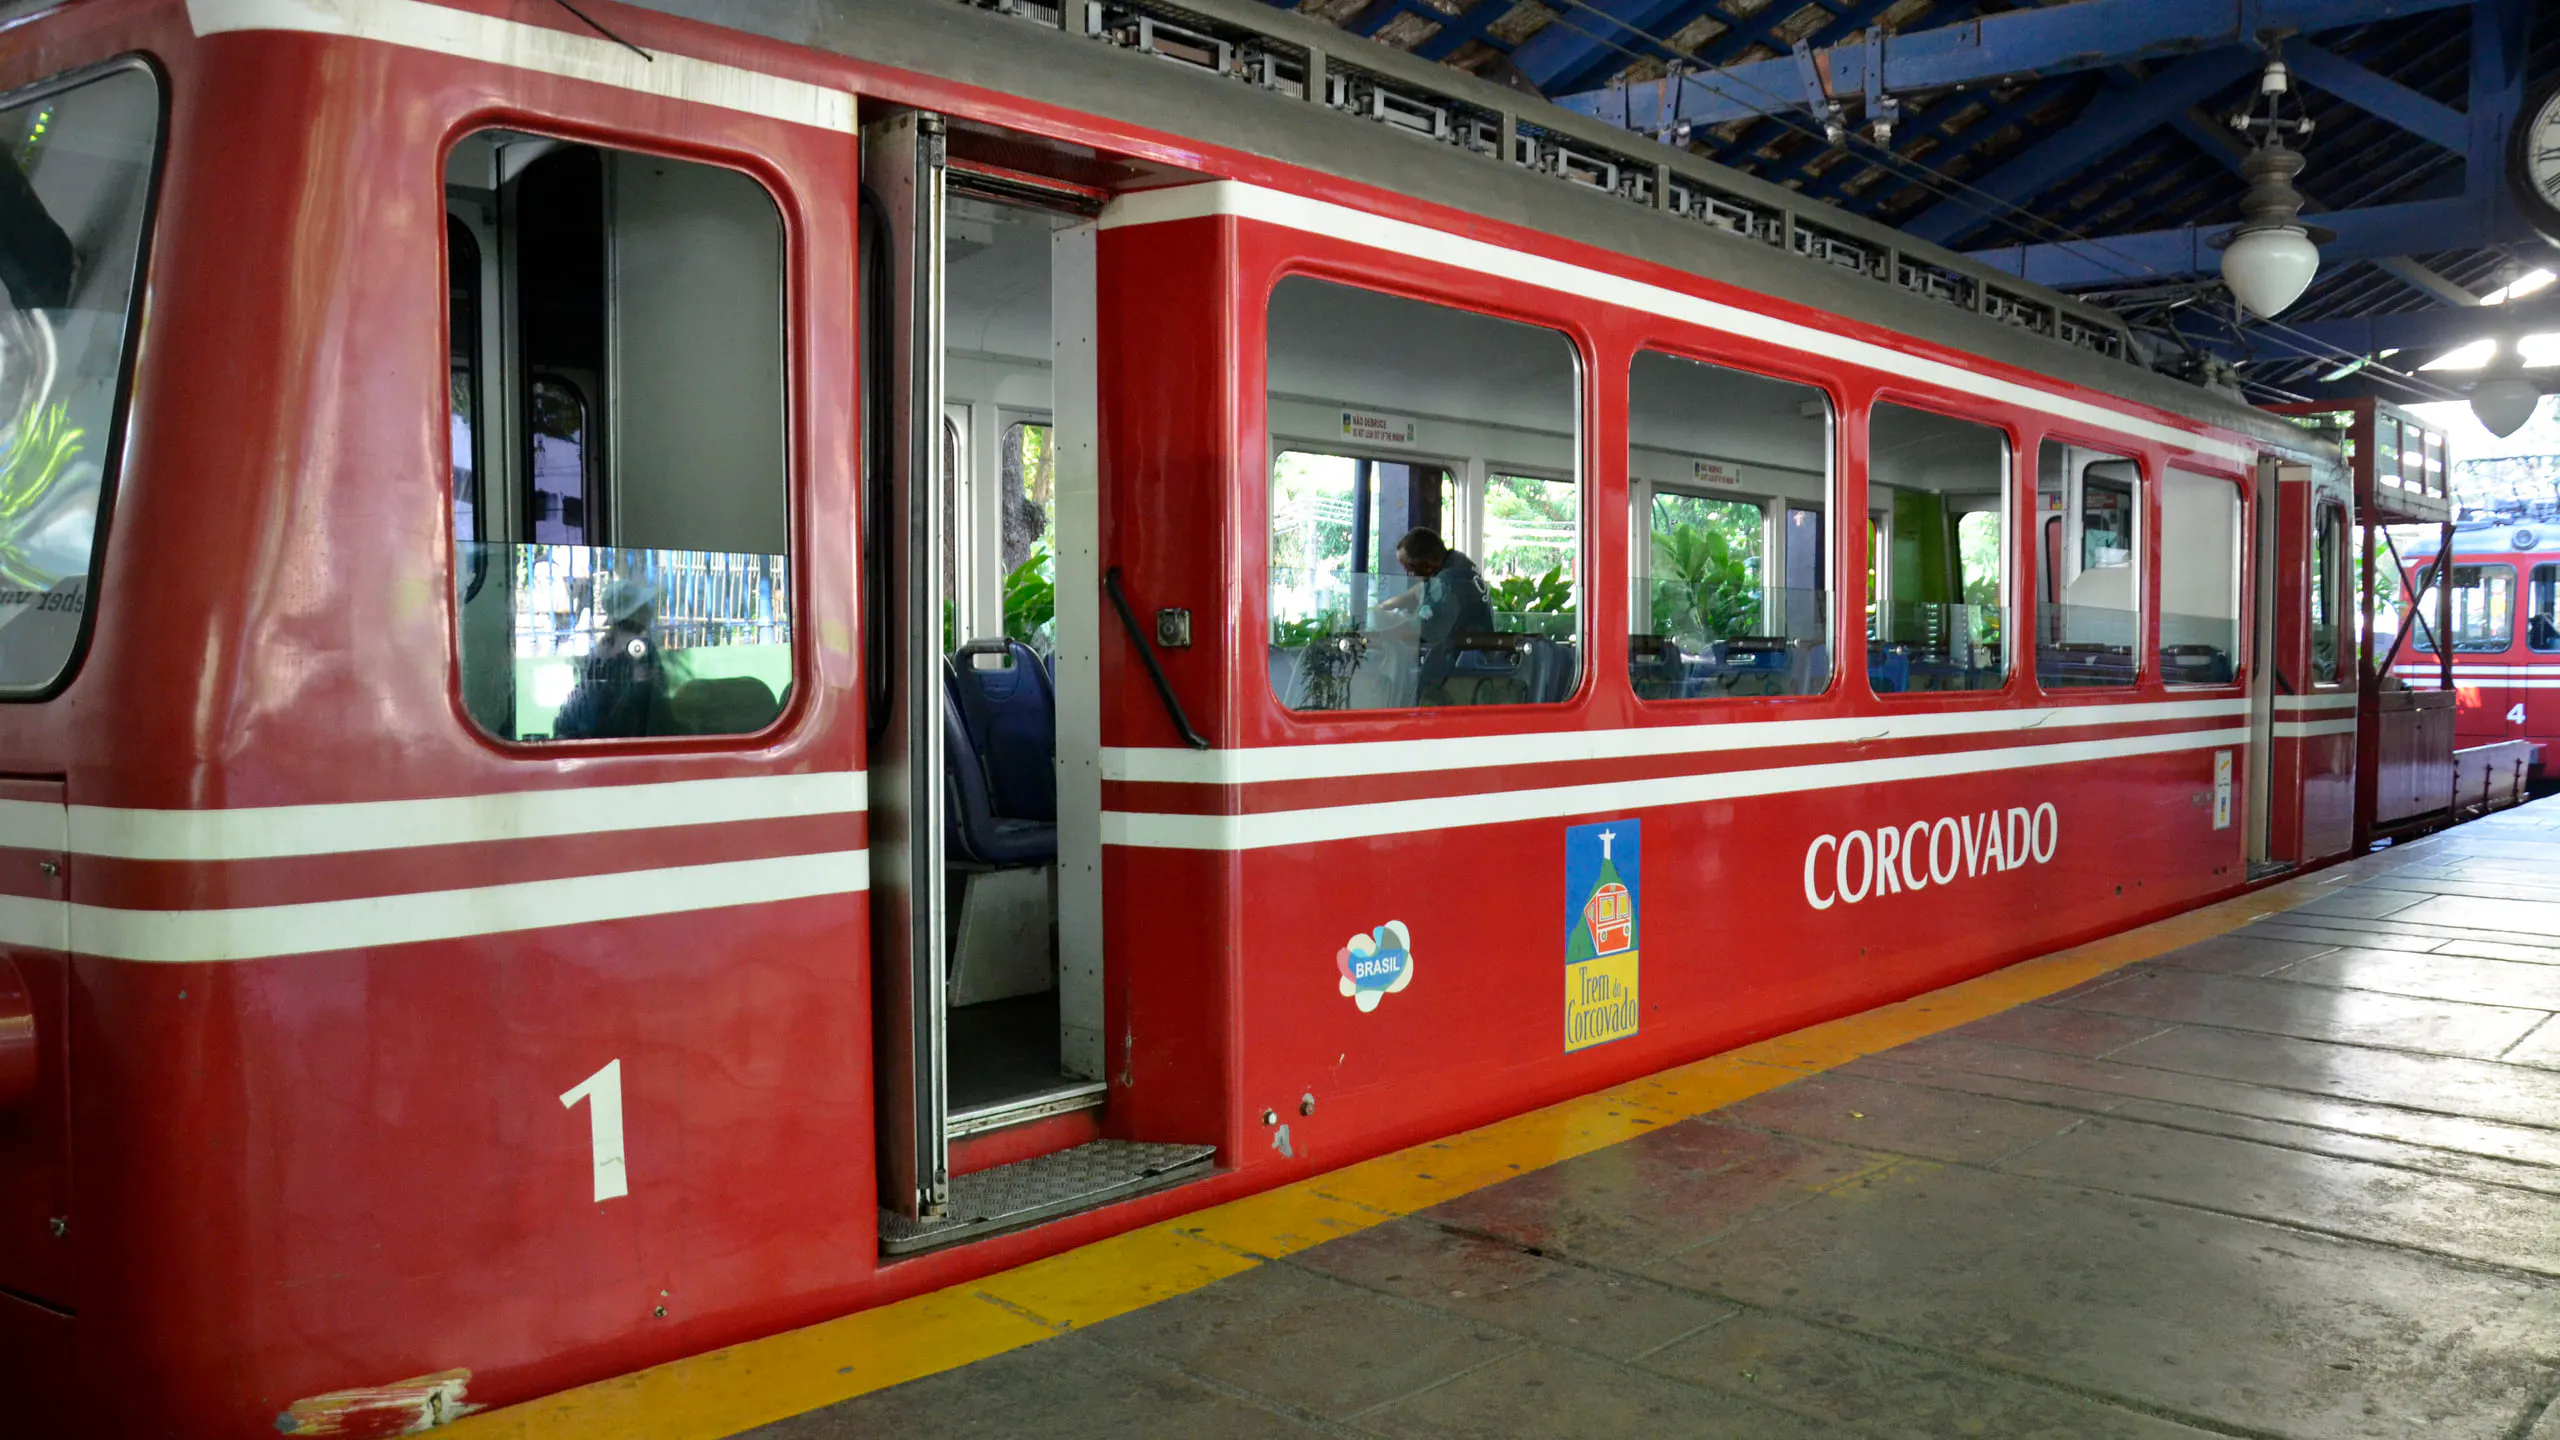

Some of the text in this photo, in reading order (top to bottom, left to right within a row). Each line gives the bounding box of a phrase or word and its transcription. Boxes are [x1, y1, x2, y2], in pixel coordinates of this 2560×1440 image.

[2506, 703, 2527, 724] 4
[1803, 801, 2058, 910] CORCOVADO
[1355, 956, 1401, 978] BRASIL
[1579, 966, 1610, 1006] Trem
[1567, 986, 1637, 1044] Corcovado
[559, 1057, 628, 1203] 1
